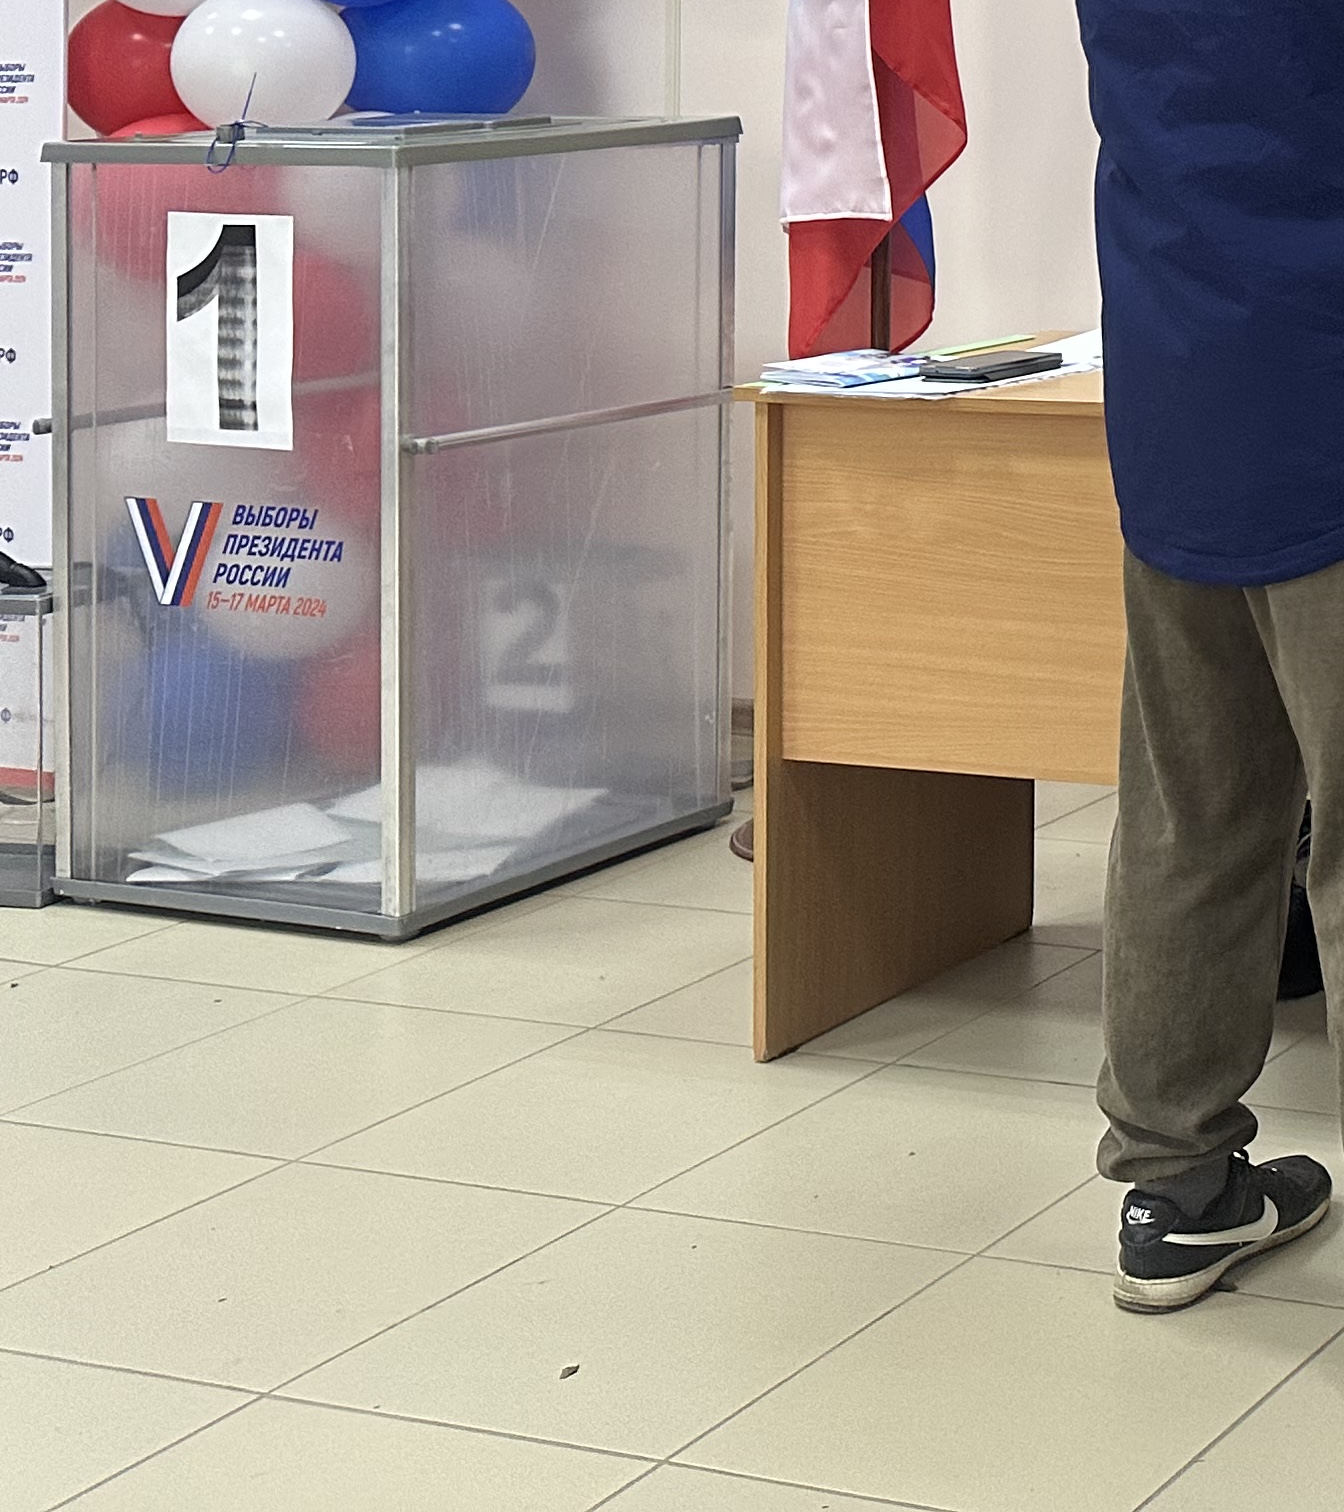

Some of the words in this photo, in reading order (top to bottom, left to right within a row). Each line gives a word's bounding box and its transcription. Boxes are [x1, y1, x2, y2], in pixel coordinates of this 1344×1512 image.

[177, 224, 259, 430] 1
[231, 504, 319, 530] ВЫБОРЫ
[222, 533, 345, 563] ПРЕЗИДЕНТА
[212, 563, 291, 589] РОССИИ
[244, 593, 291, 615] МАРТА
[293, 597, 328, 618] 2024
[1130, 1205, 1152, 1221] NIKE
